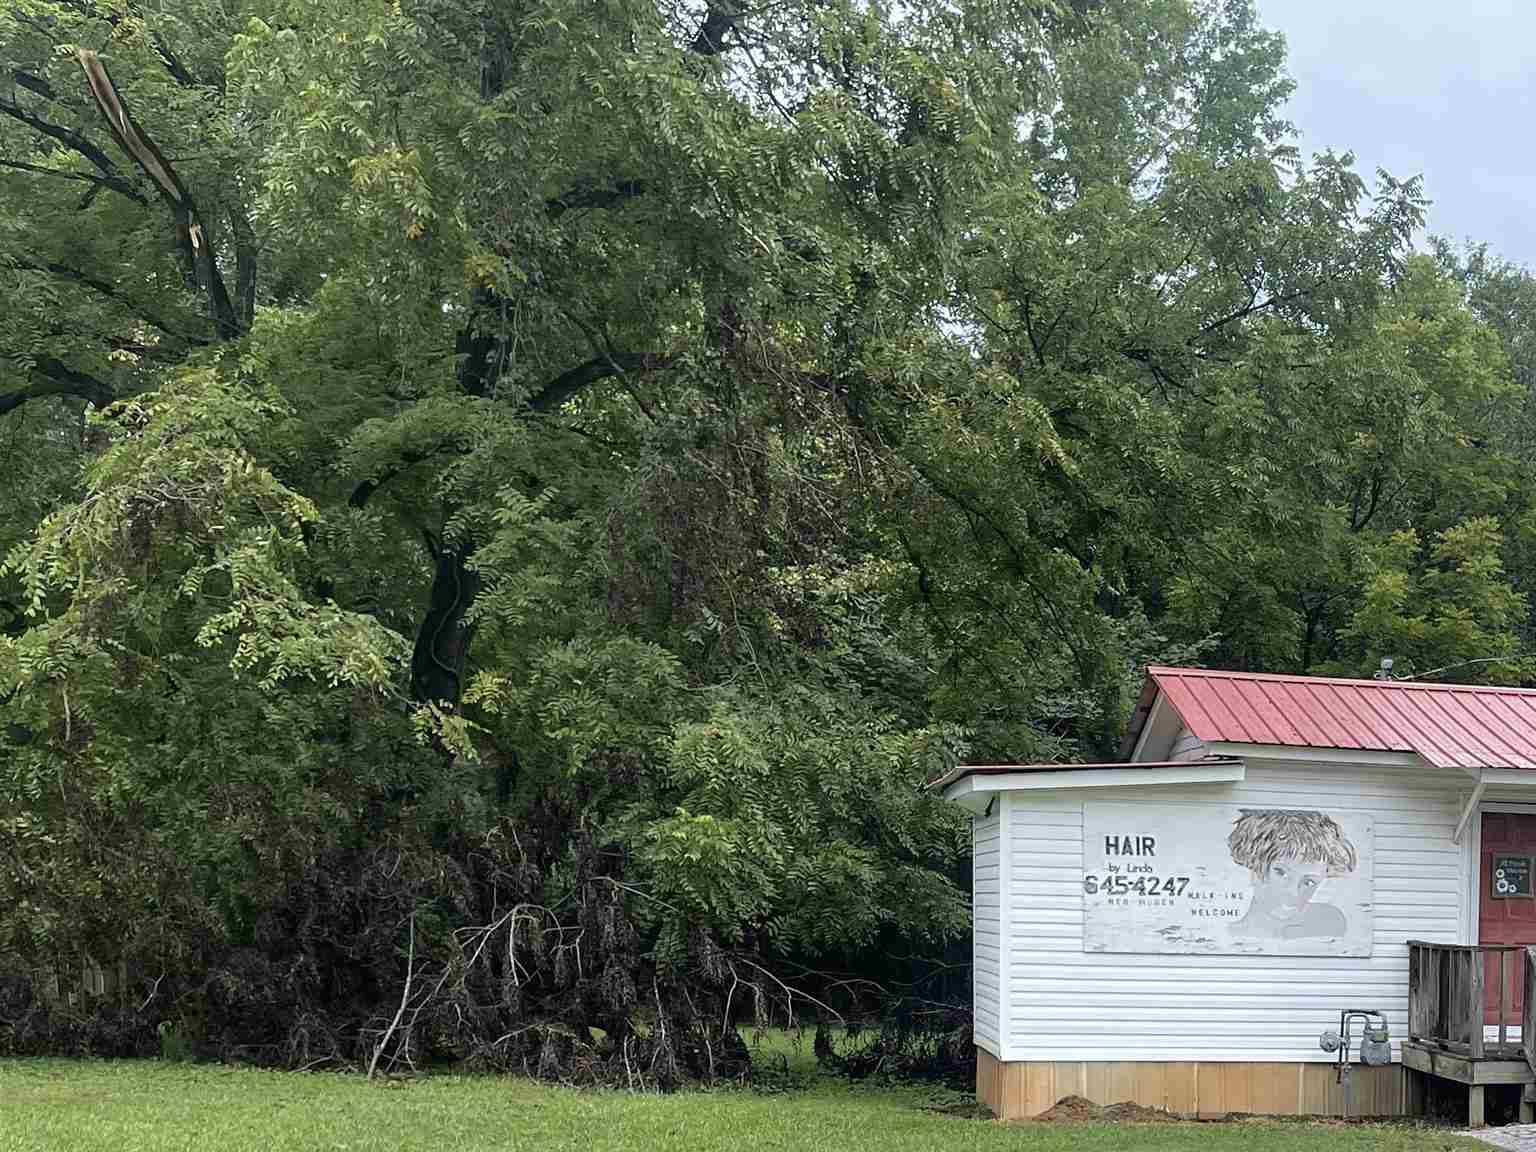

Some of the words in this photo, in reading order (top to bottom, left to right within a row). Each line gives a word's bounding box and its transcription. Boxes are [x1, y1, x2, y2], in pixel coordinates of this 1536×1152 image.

[1105, 835, 1156, 857] HAIR
[1108, 863, 1121, 873] by
[1127, 863, 1153, 873] Linda
[1191, 908, 1240, 917] WELCOME
